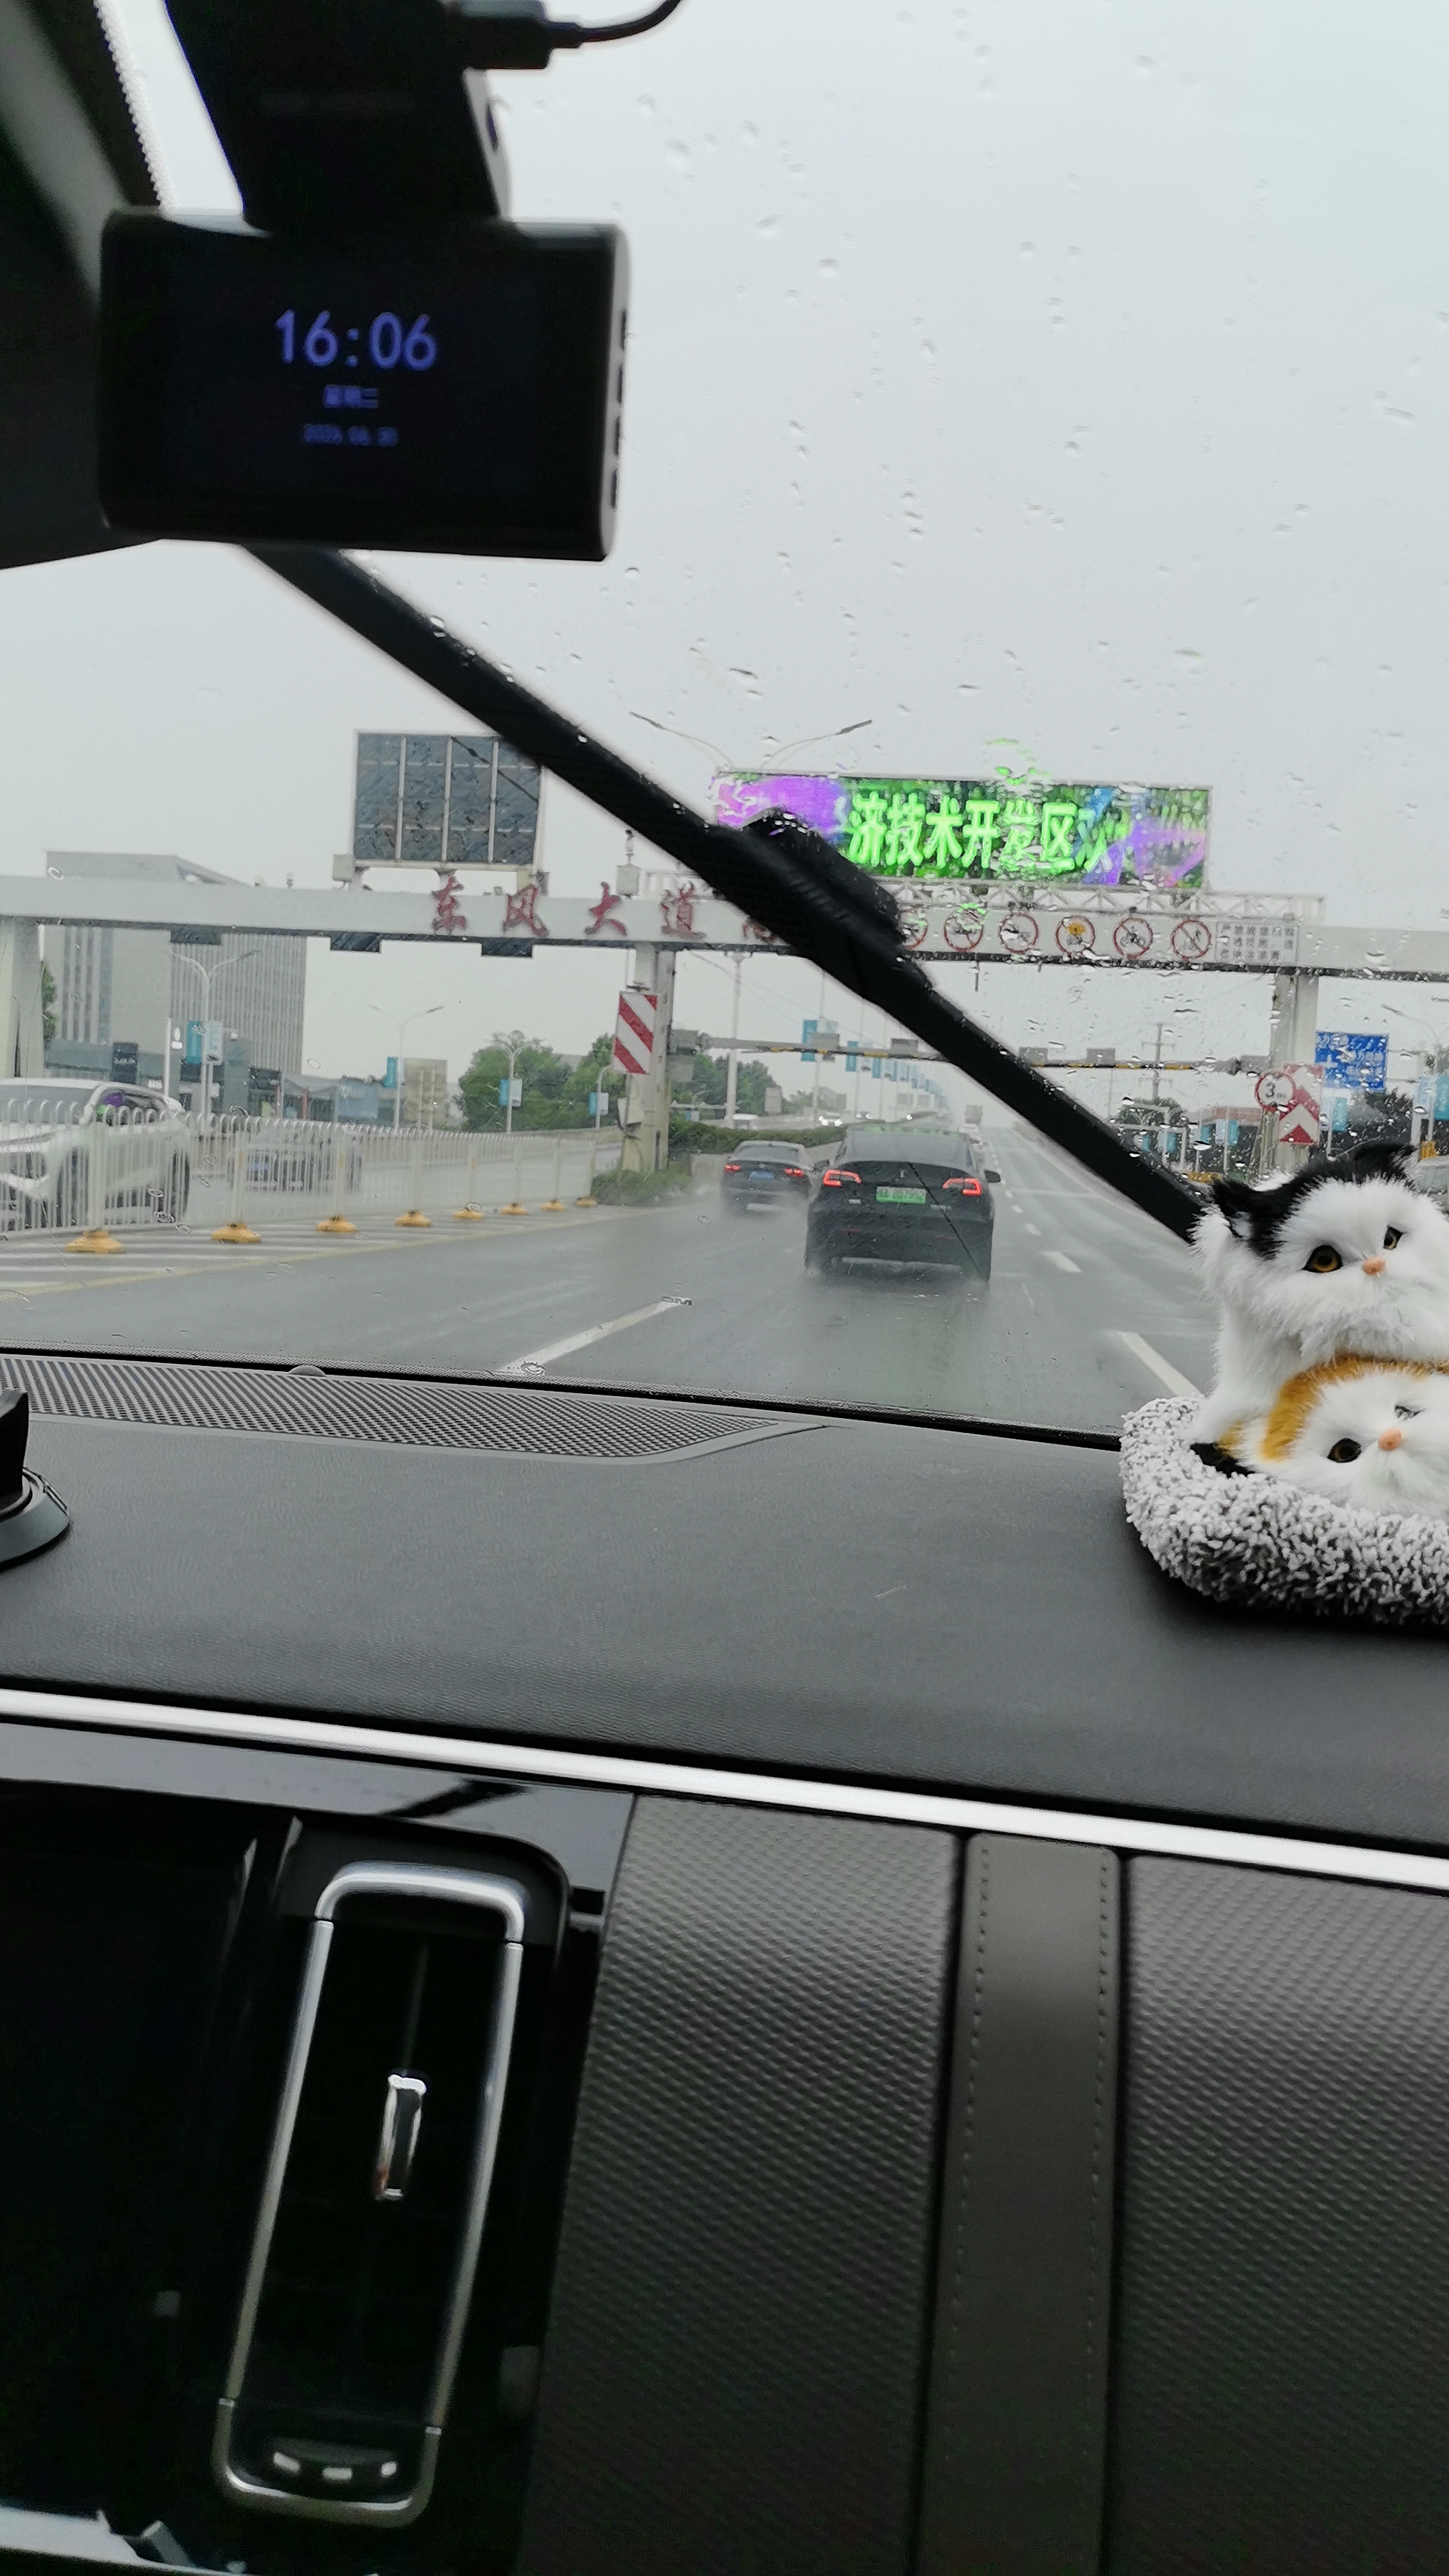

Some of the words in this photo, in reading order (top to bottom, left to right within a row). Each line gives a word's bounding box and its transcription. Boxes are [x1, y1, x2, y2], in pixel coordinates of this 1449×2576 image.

[275, 309, 437, 370] 16:06
[431, 875, 778, 943] 东风大道
